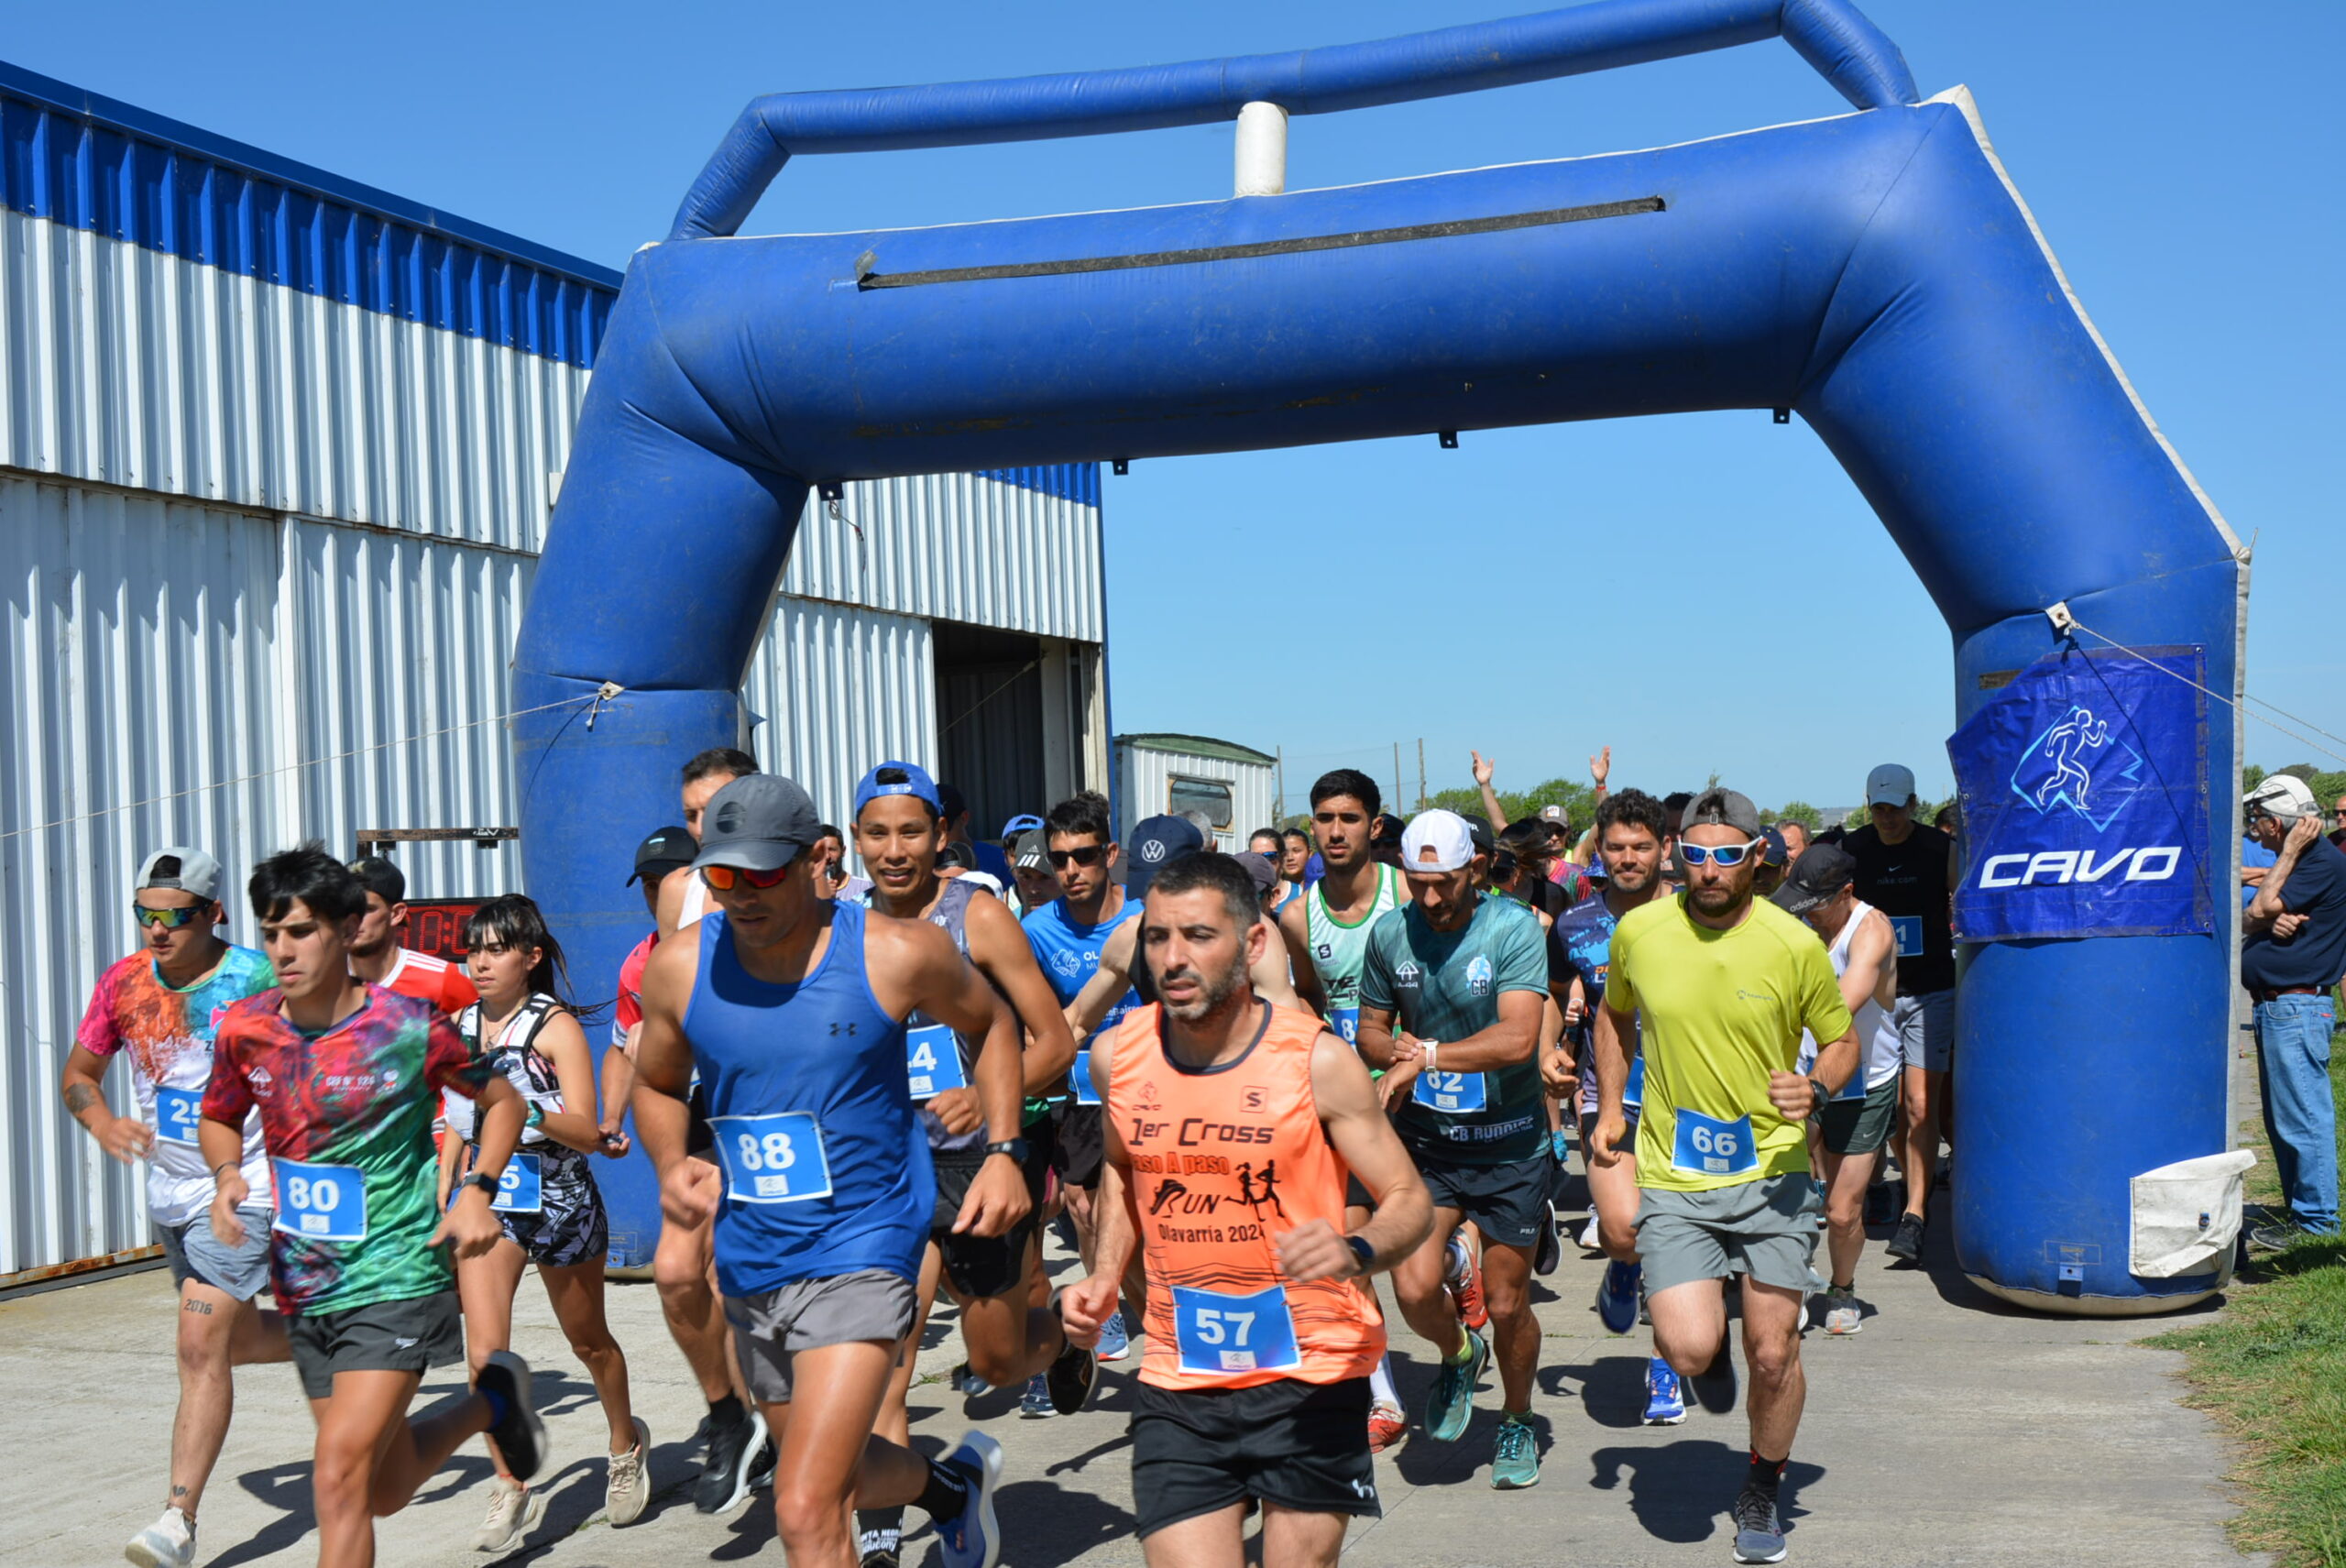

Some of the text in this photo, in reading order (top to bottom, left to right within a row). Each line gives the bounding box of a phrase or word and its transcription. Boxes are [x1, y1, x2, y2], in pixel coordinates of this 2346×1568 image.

[1979, 847, 2182, 889] CAVO
[1790, 897, 1818, 913] adidas
[1472, 980, 1488, 996] CB
[907, 1042, 937, 1071] 4
[1129, 1118, 1275, 1146] 1er Cross
[1450, 1126, 1469, 1141] CB
[1692, 1125, 1738, 1157] 66
[738, 1133, 795, 1170] 88
[1167, 1151, 1181, 1174] A
[1182, 1155, 1230, 1176] paso
[288, 1176, 340, 1212] 80
[183, 1298, 213, 1315] 2016
[1196, 1308, 1255, 1347] 57
